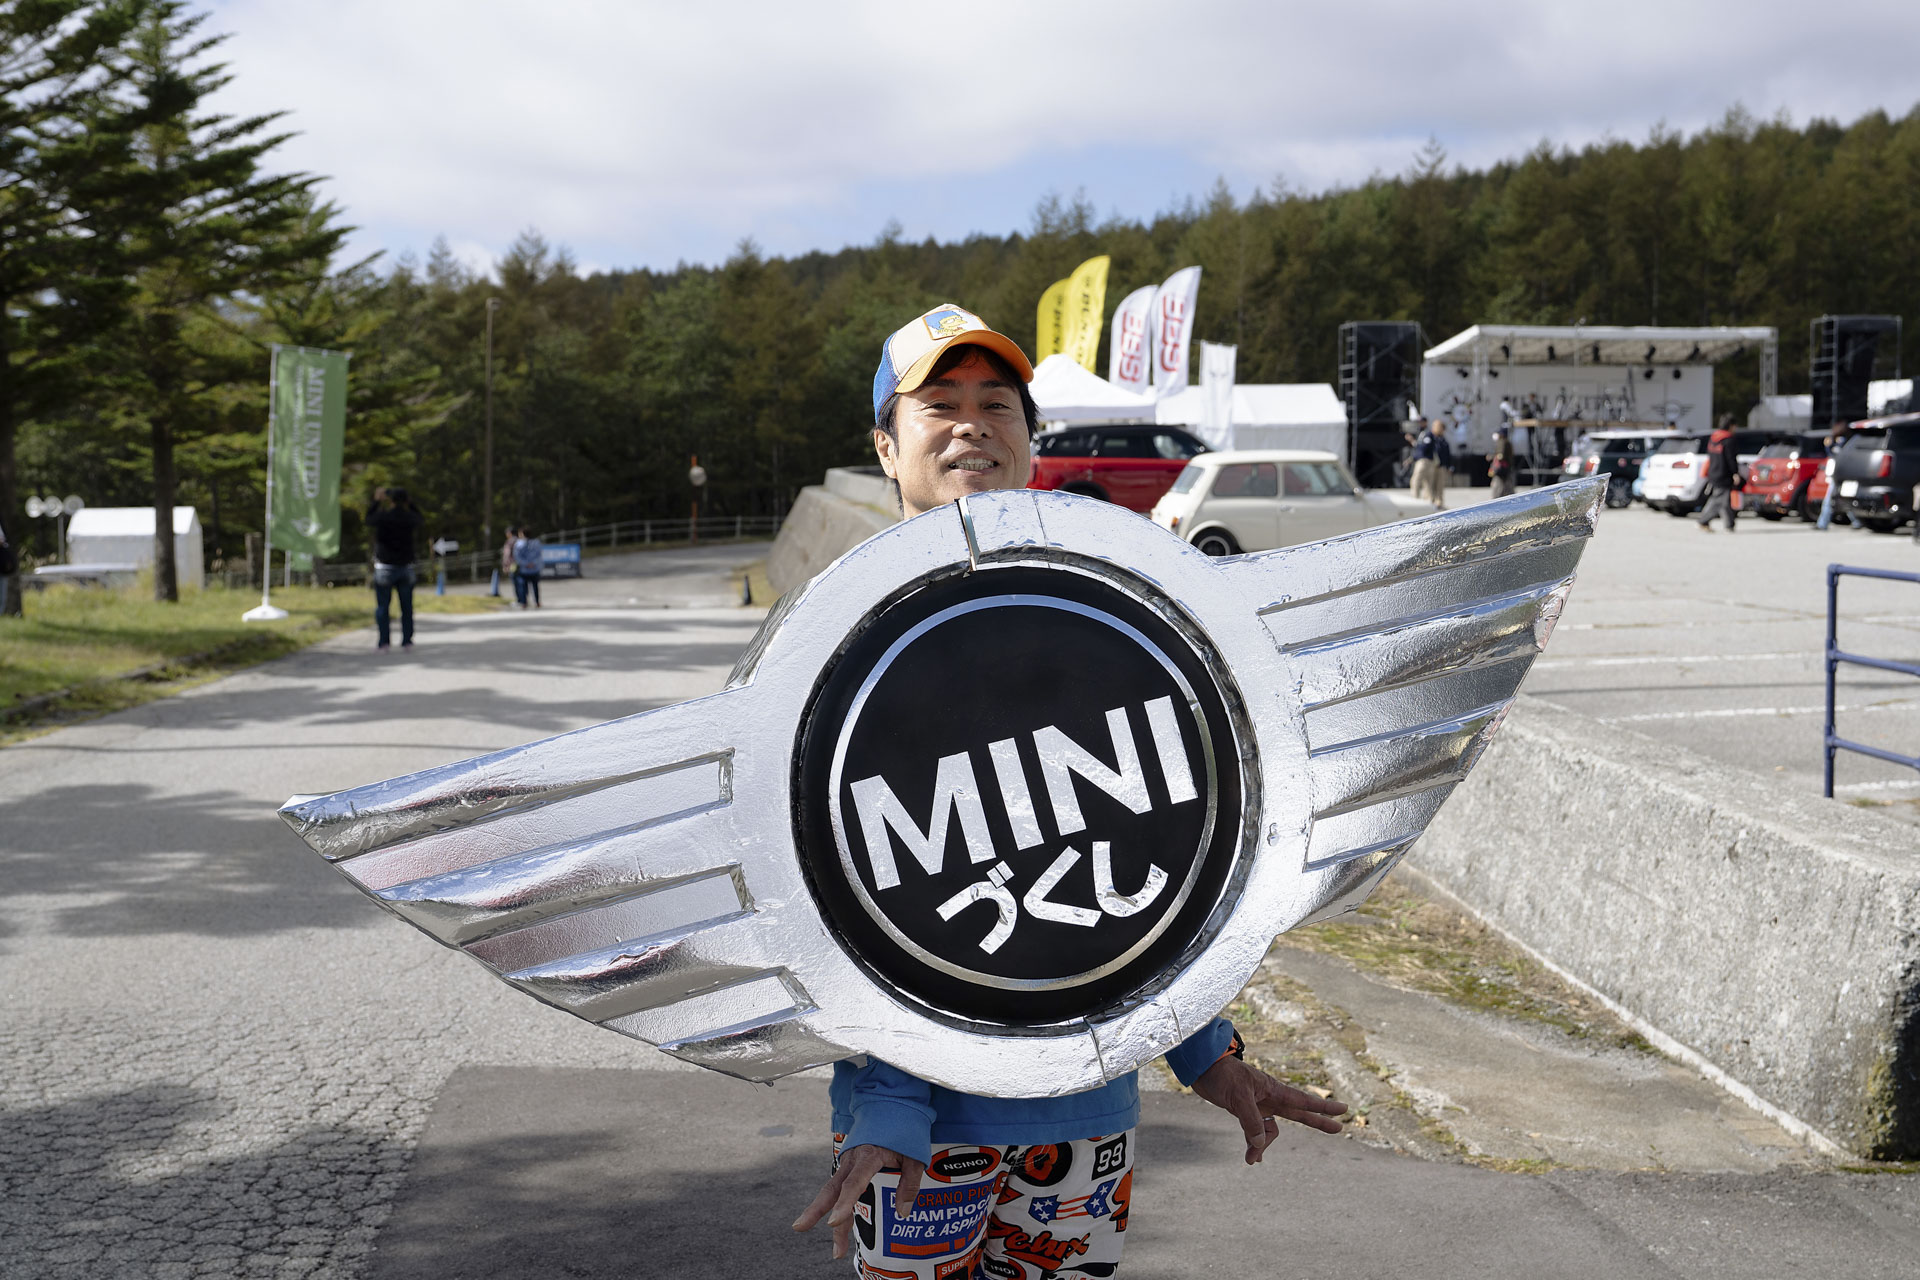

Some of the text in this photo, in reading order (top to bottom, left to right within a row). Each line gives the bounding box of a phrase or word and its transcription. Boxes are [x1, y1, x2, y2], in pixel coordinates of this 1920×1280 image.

[303, 366, 325, 499] MINI UNITED
[850, 695, 1198, 891] MINI
[935, 840, 1169, 956] づくし
[1097, 1142, 1124, 1173] 99
[891, 1224, 923, 1238] DIRT
[924, 1225, 936, 1238] &
[917, 1190, 963, 1207] CRANO
